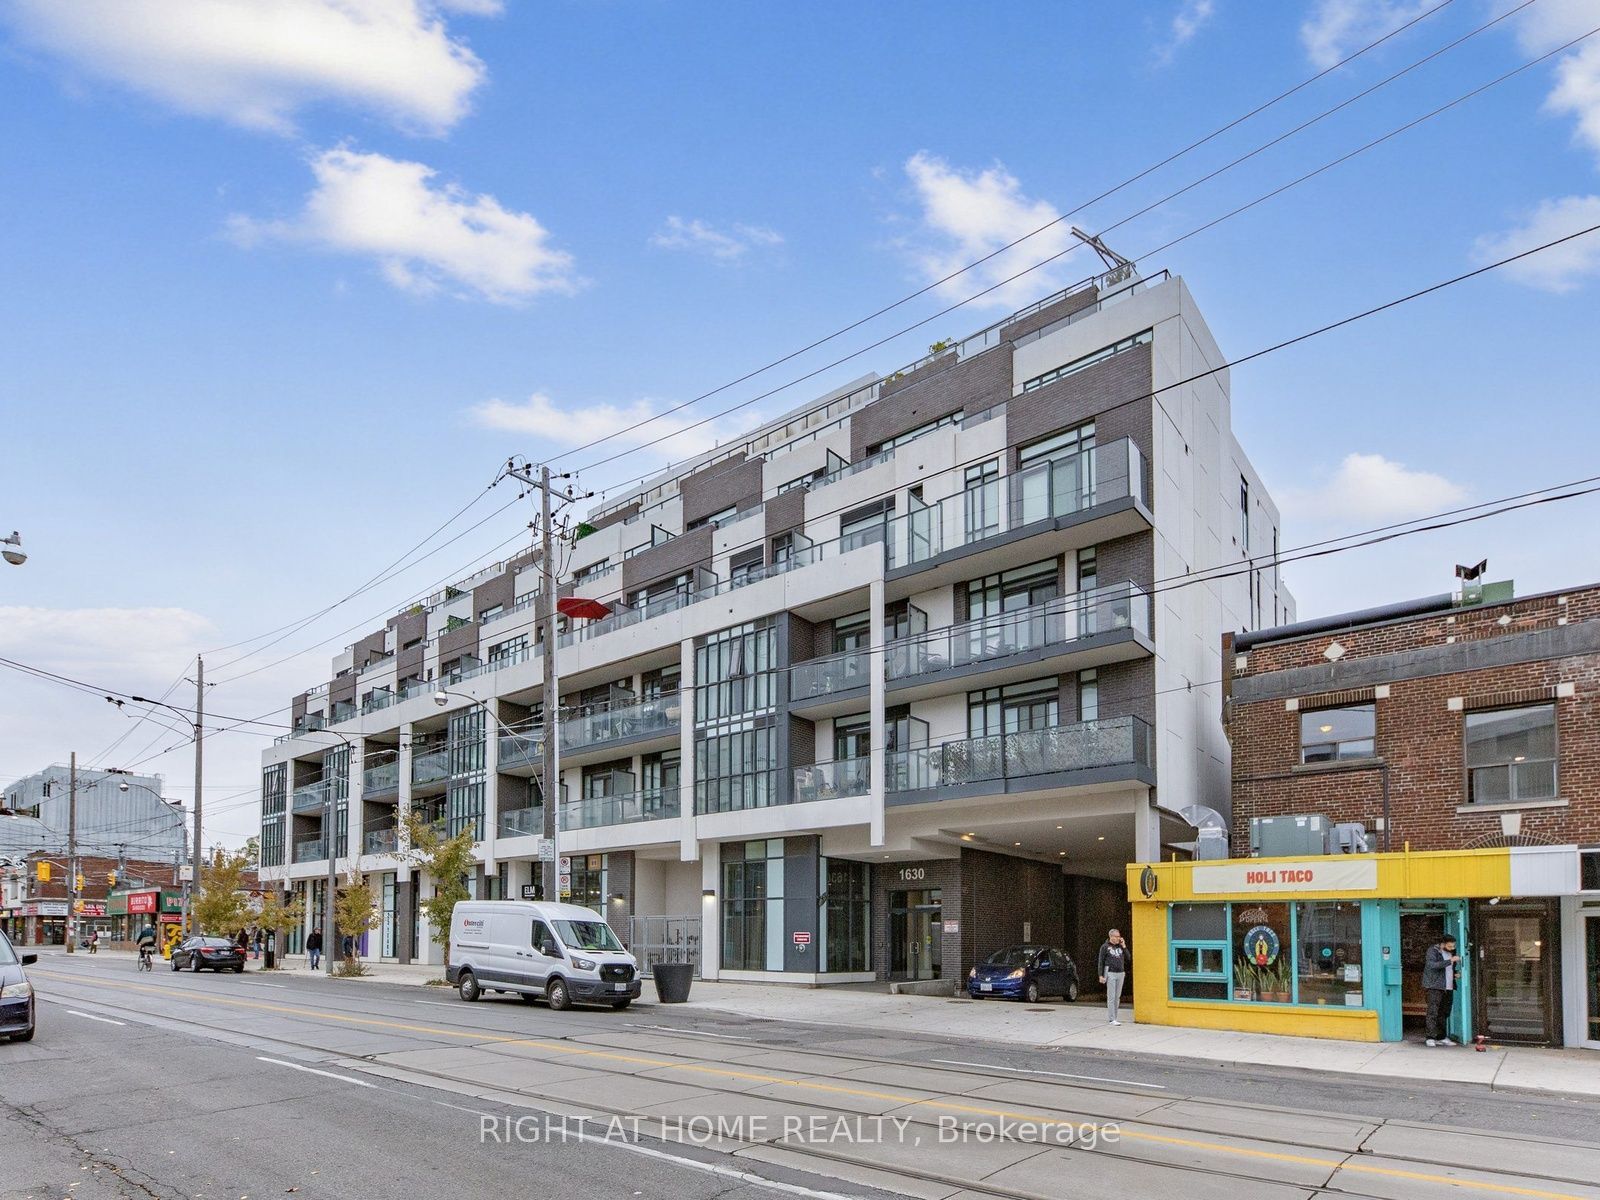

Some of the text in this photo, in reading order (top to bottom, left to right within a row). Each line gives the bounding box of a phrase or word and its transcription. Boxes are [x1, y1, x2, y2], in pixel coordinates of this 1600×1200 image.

[899, 868, 925, 880] 1630
[1247, 870, 1313, 883] HOLI TACO
